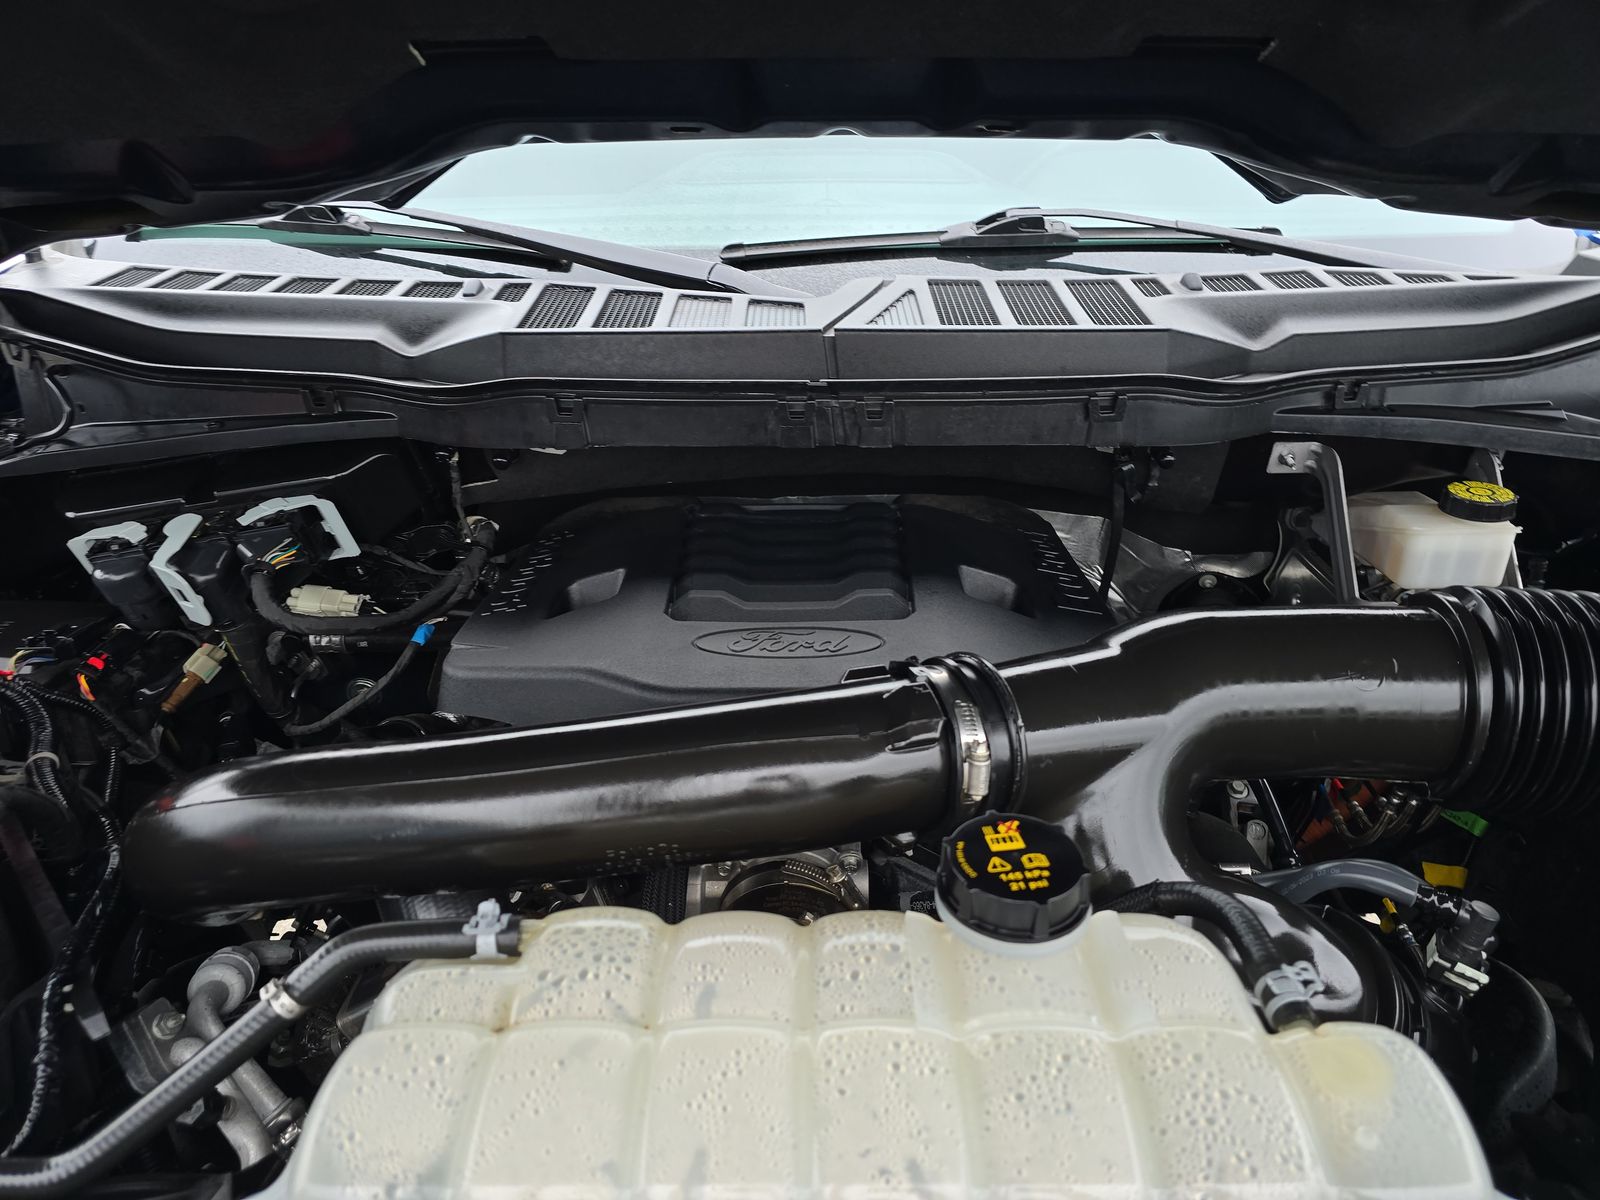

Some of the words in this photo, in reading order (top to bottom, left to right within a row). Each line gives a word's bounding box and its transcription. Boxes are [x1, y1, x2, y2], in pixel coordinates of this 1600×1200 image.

[727, 630, 851, 653] Ford
[999, 871, 1024, 882] 145
[1024, 869, 1050, 879] kPa
[1009, 881, 1027, 892] 21
[1028, 879, 1049, 891] psi
